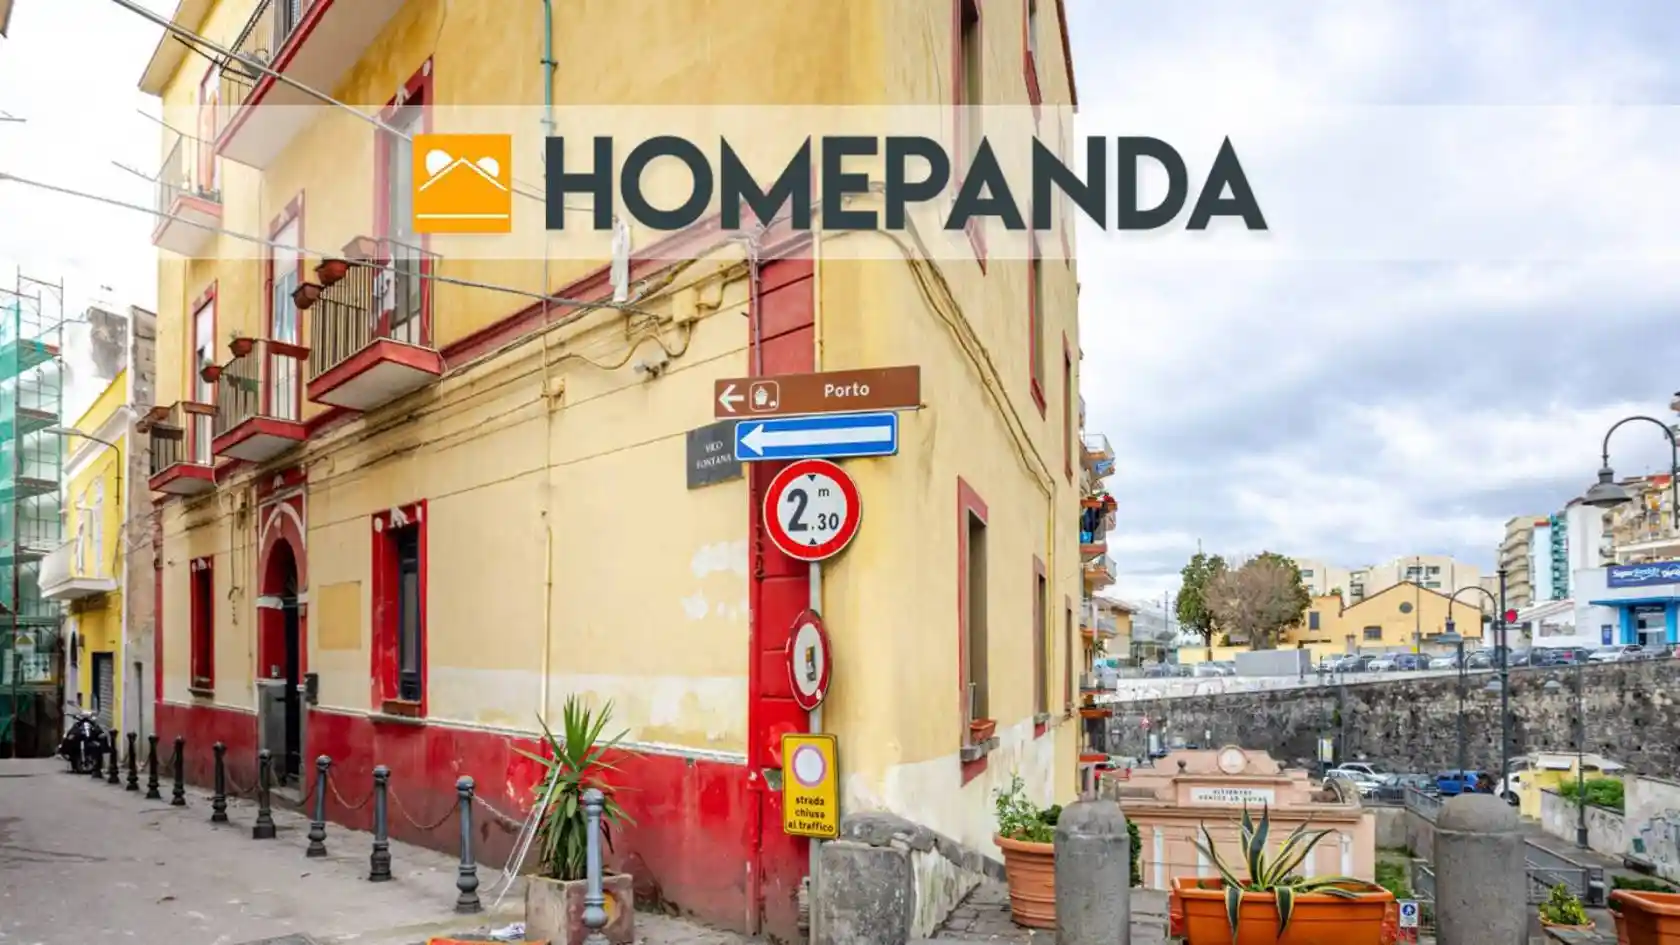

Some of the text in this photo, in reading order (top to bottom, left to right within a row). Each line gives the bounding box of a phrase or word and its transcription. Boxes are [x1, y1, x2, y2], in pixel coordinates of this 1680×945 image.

[824, 382, 870, 398] Porto
[818, 488, 830, 497] m
[795, 796, 825, 806] strada
[794, 808, 825, 819] chiusa
[788, 820, 834, 832] al traffico
